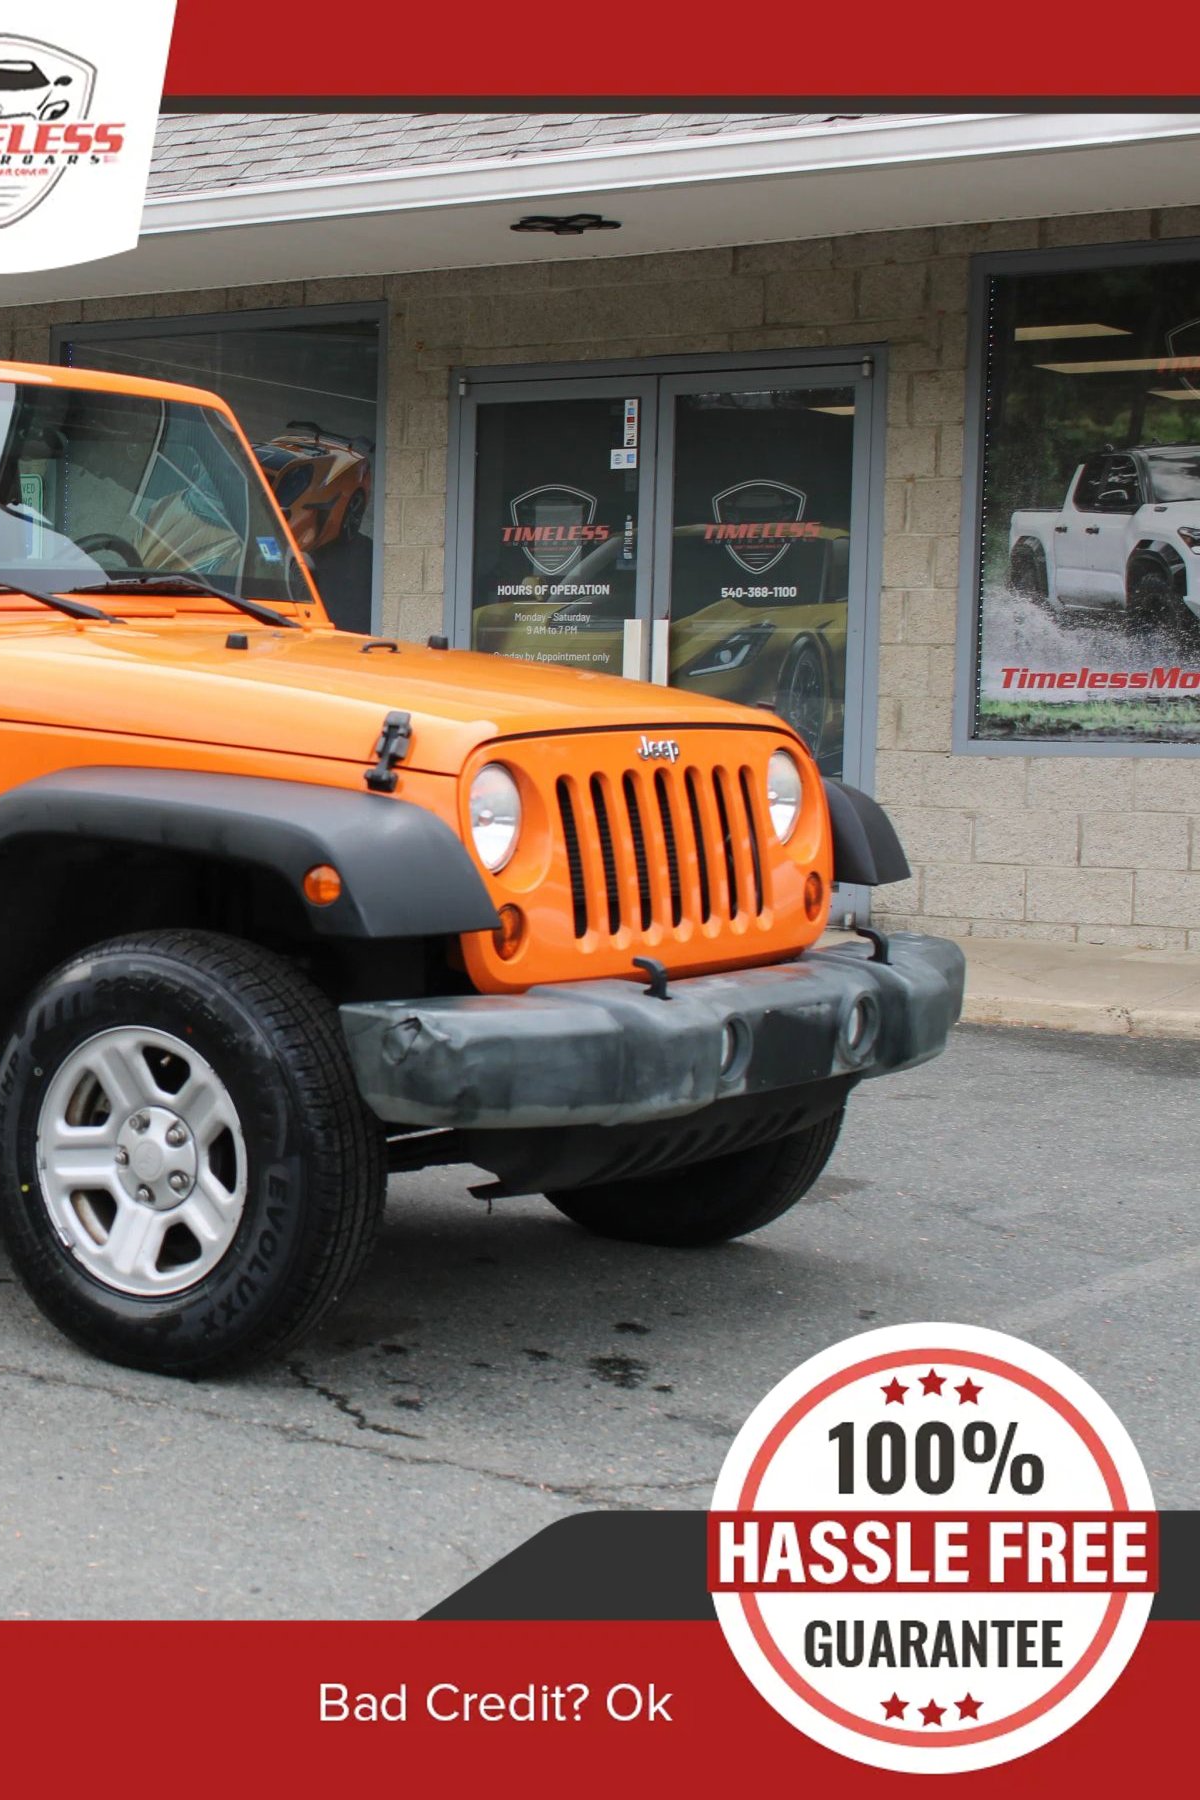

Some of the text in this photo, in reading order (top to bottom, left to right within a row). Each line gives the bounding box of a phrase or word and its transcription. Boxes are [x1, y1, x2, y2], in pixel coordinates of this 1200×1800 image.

[502, 525, 610, 542] TIMELESS
[704, 522, 820, 539] TIMELESS
[497, 584, 610, 595] HOURS OF OPERATION
[721, 587, 797, 598] 540-368-1100
[514, 612, 546, 622] Monday
[553, 612, 591, 623] Saturday
[526, 626, 577, 635] 9 AM to 7 PM
[525, 652, 535, 661] by
[537, 652, 590, 664] Appointment
[592, 652, 610, 664] only
[1001, 667, 1200, 688] TimelessMo
[636, 735, 679, 764] Jeep
[199, 1174, 291, 1334] EVOLUXX
